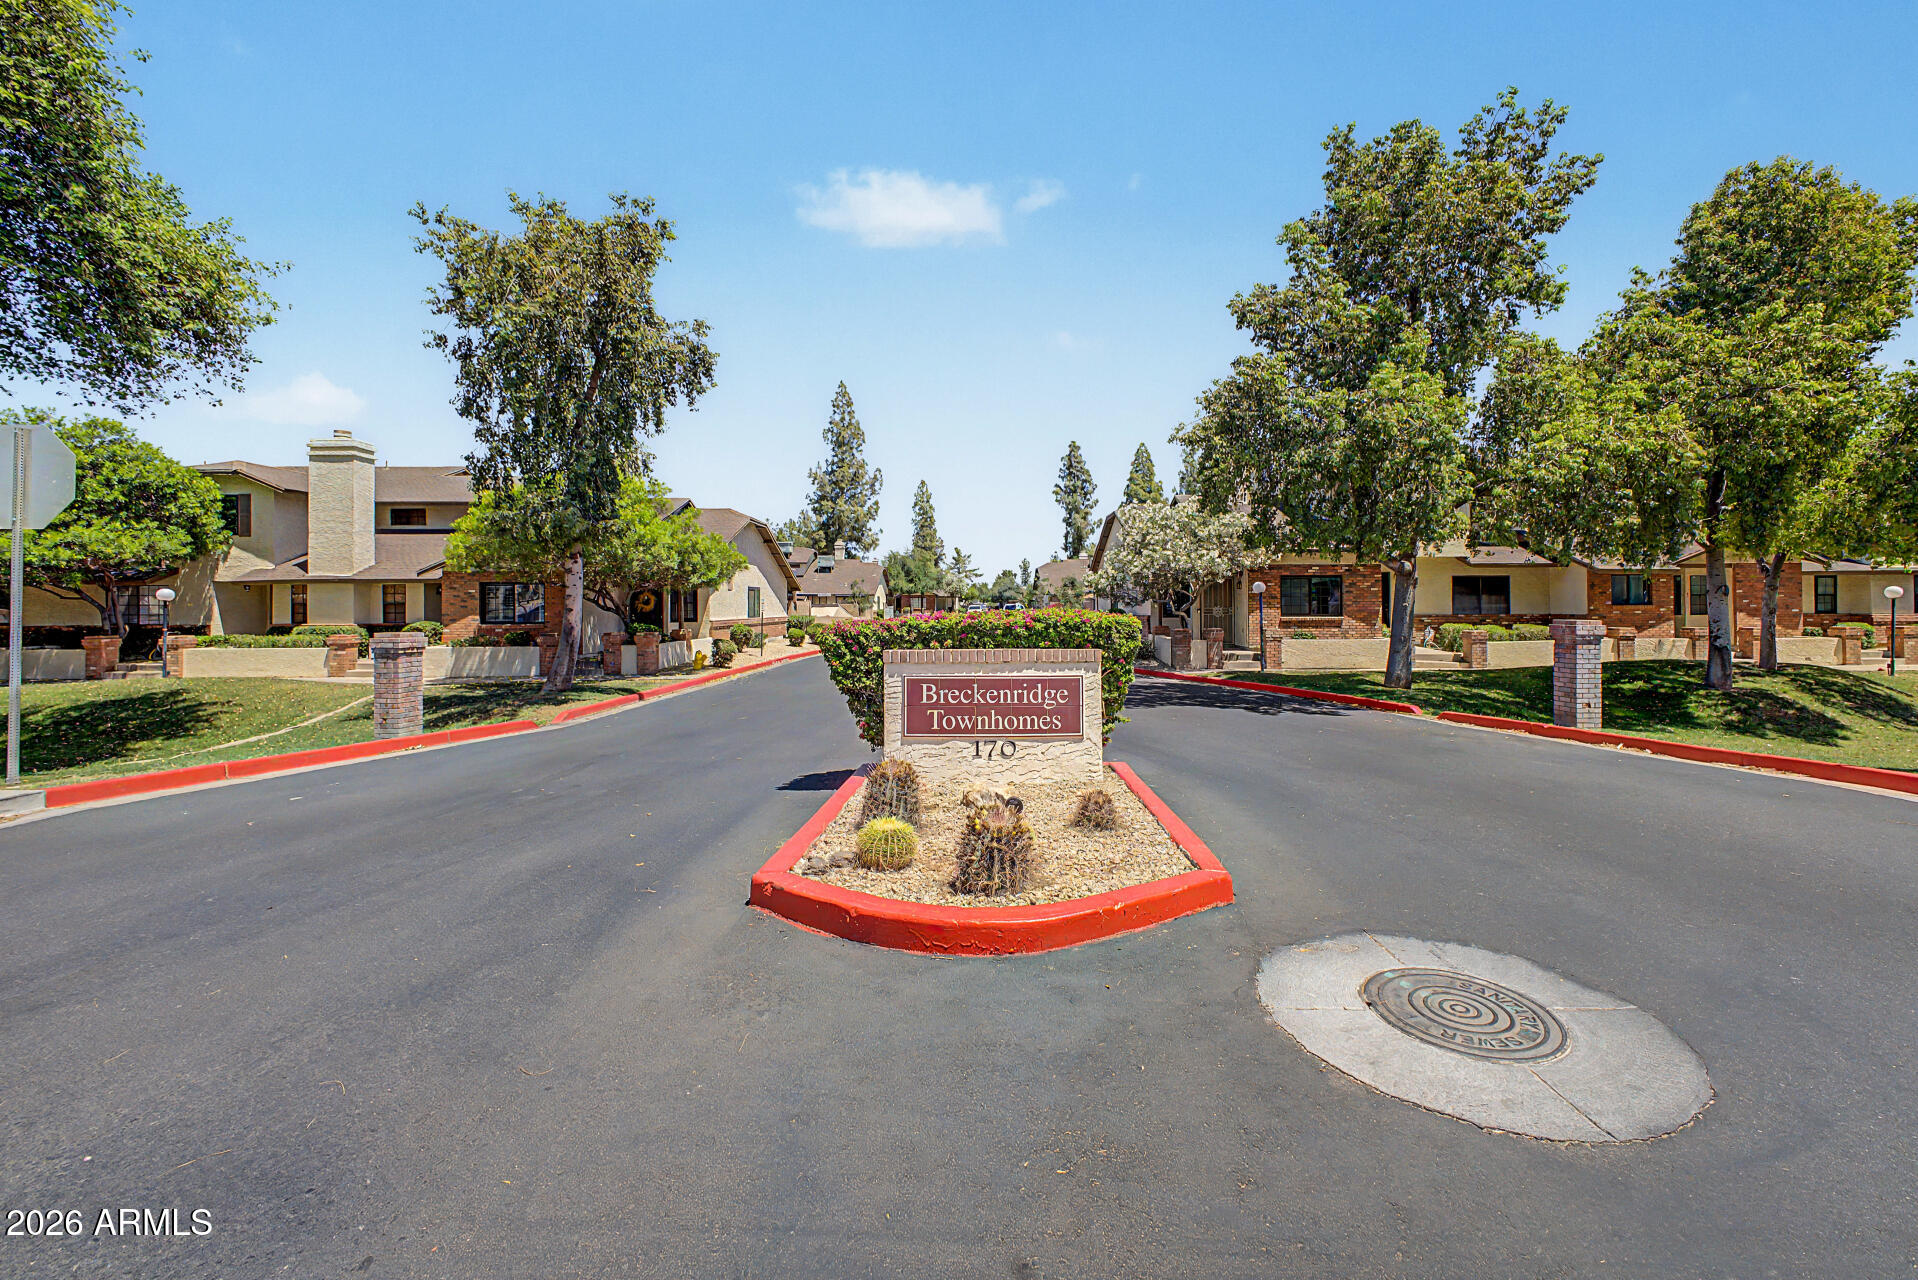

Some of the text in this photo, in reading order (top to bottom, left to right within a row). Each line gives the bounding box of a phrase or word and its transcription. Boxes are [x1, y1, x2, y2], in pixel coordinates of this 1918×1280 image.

[920, 683, 1069, 709] Breckenridge
[927, 709, 1062, 730] Townhomes
[972, 740, 1017, 760] 170
[1440, 1028, 1523, 1048] SEWER
